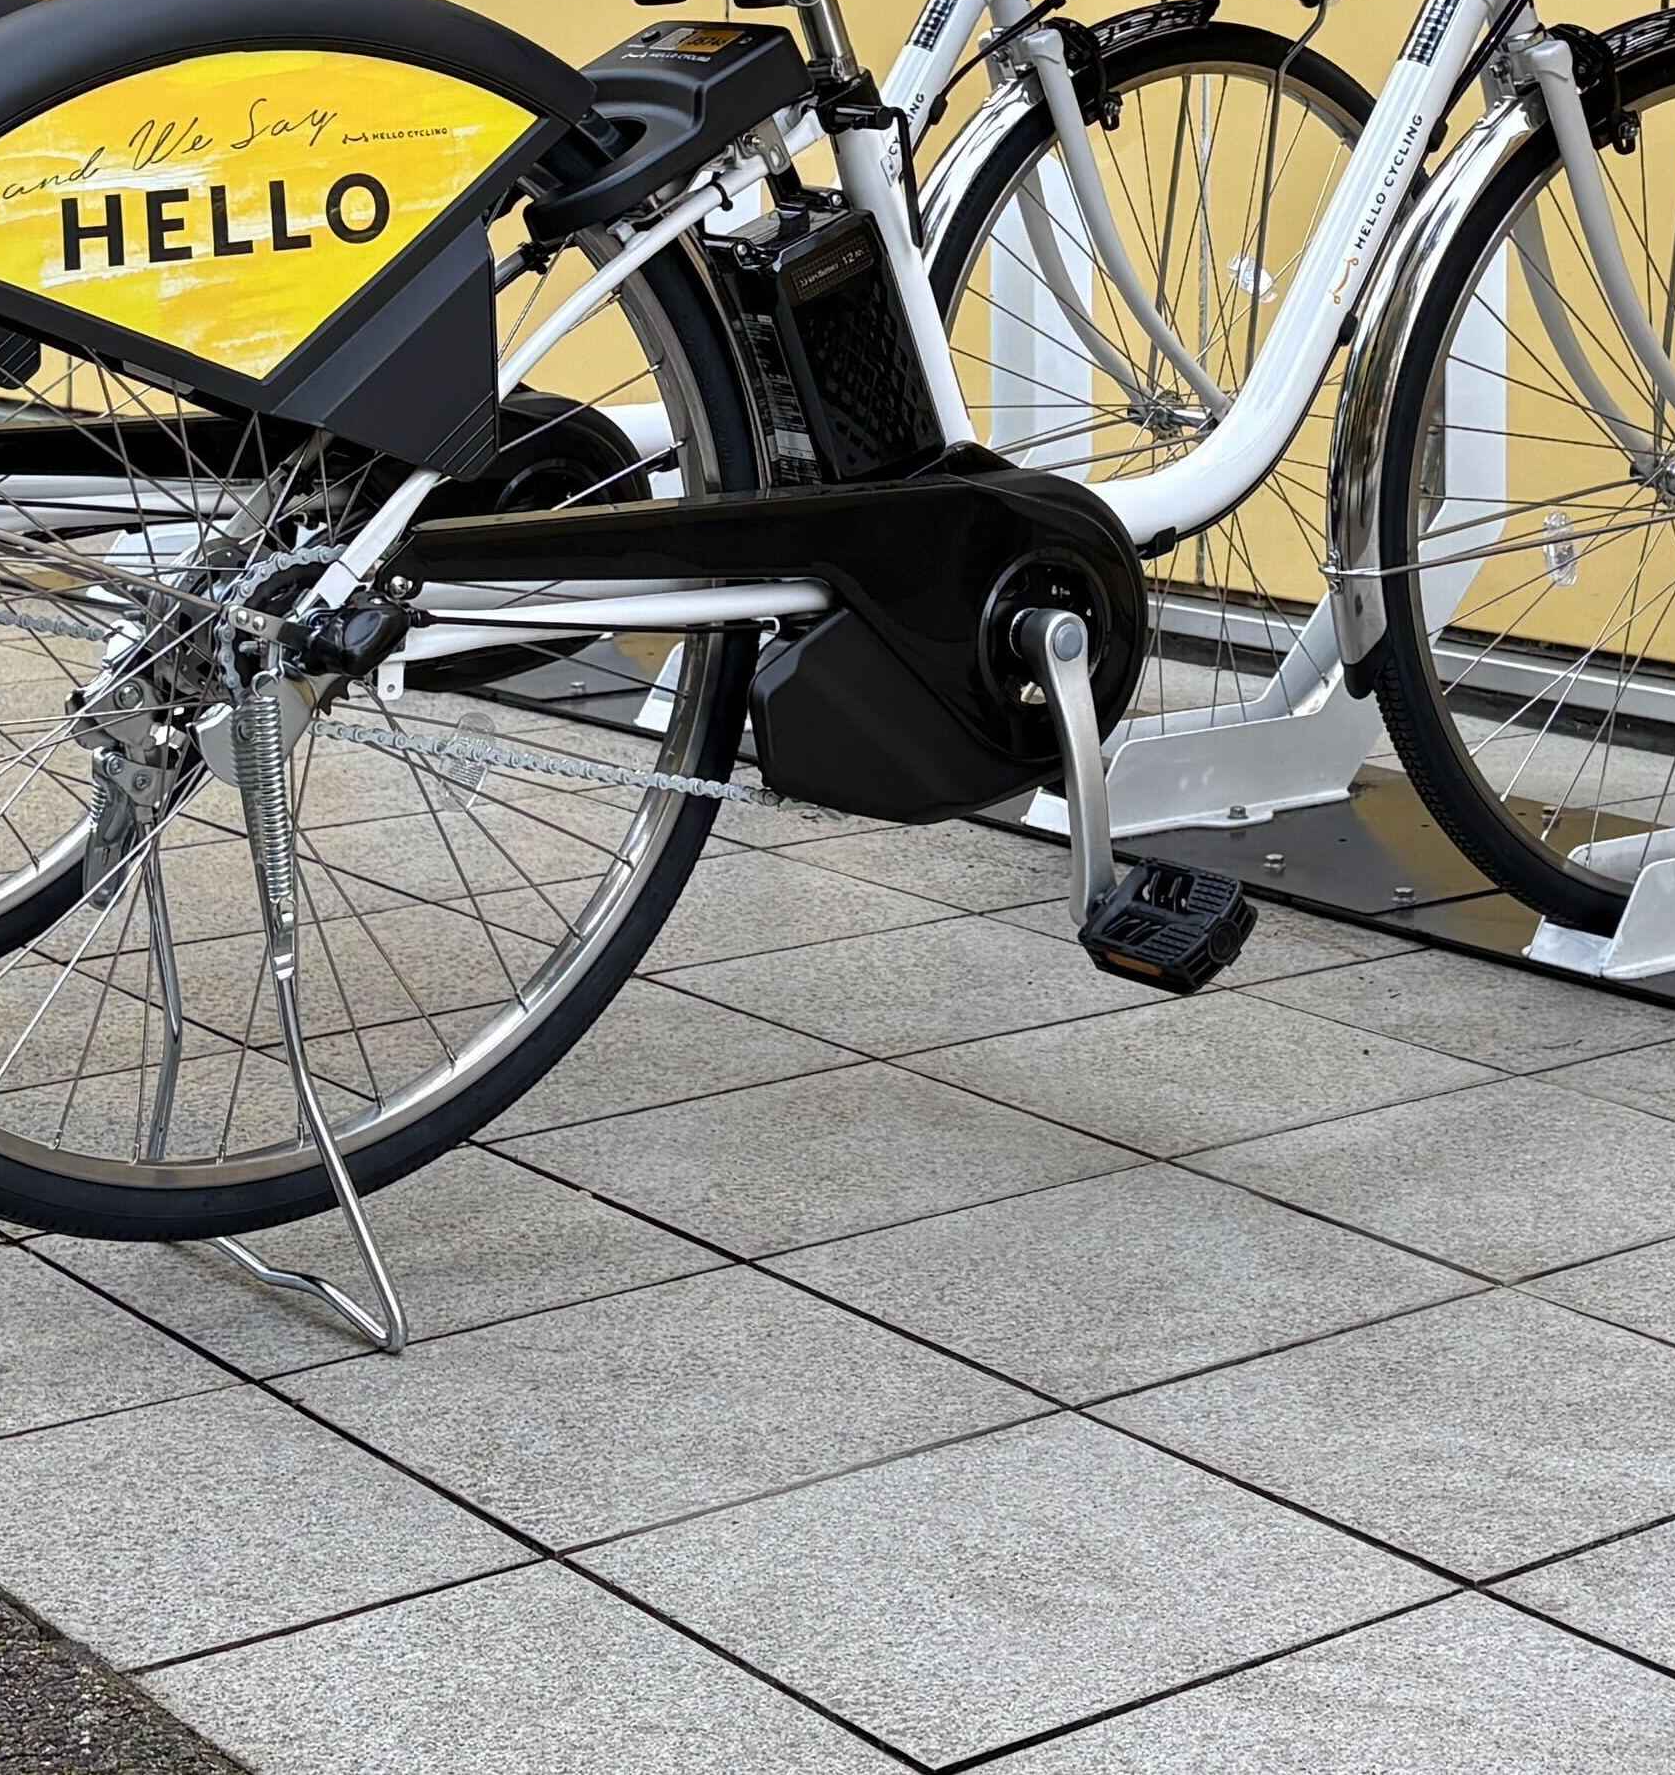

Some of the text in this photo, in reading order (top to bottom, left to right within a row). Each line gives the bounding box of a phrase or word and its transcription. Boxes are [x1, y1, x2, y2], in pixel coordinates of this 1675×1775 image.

[1, 97, 338, 201] and We Say
[372, 131, 405, 140] HELLO
[1354, 114, 1423, 250] HELLO CYCLING
[61, 171, 391, 272] HELLO
